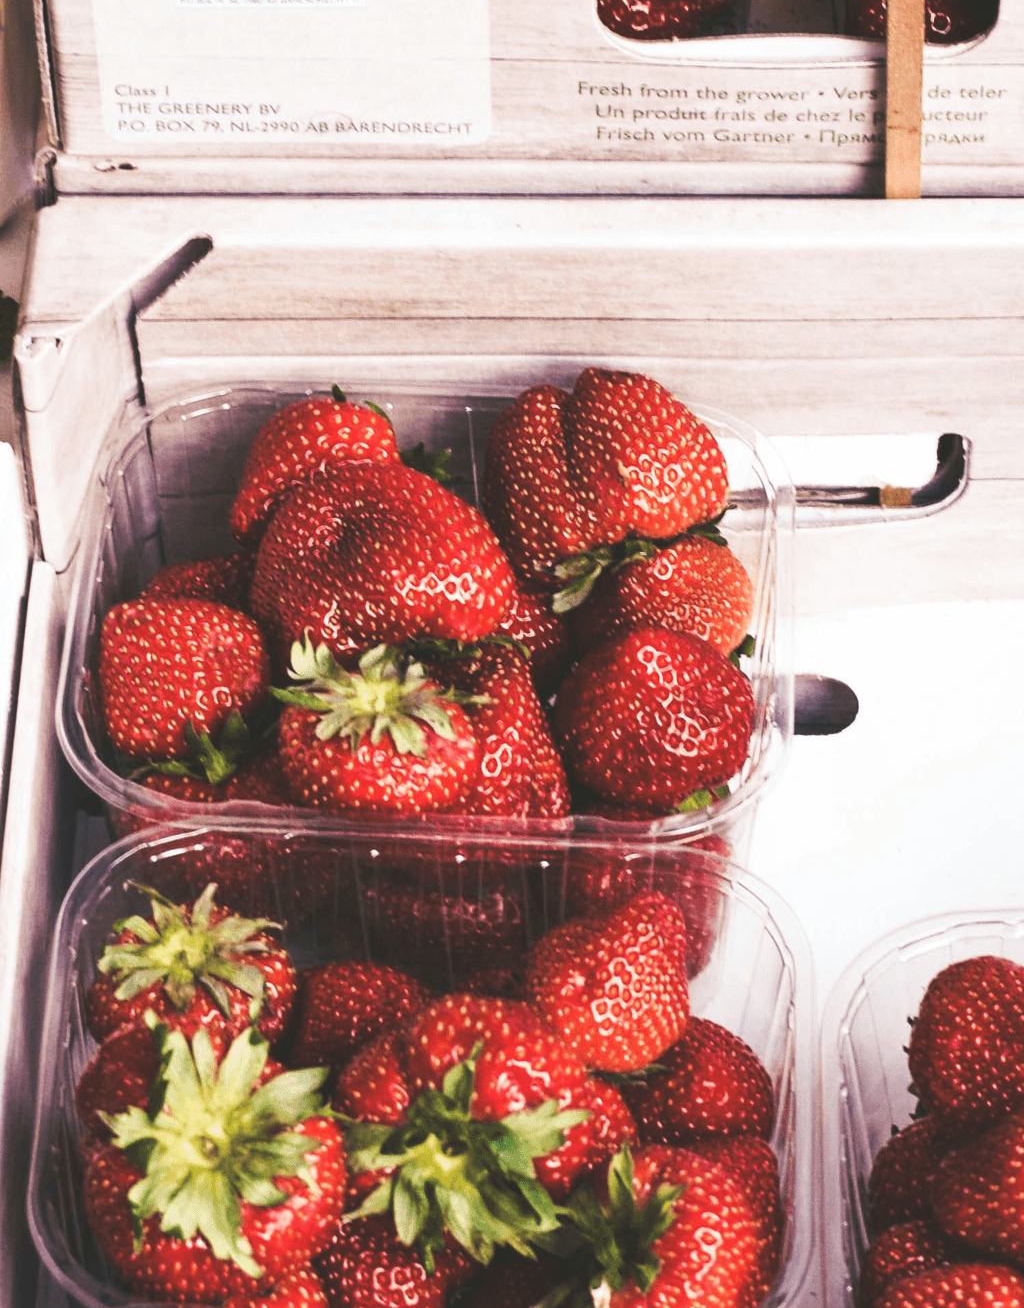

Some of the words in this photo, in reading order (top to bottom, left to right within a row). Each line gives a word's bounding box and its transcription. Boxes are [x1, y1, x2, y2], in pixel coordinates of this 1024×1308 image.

[114, 84, 157, 98] Class
[578, 81, 632, 97] Fresh
[640, 83, 688, 98] from
[697, 86, 728, 100] the
[736, 90, 809, 104] grower
[927, 85, 951, 99] de
[960, 85, 1007, 99] teler
[116, 102, 152, 116] THE
[159, 103, 253, 116] GREENERY
[258, 103, 282, 116] BV
[595, 104, 625, 119] Un
[632, 107, 706, 122] produit
[714, 107, 756, 122] frais
[764, 109, 788, 122] de
[796, 109, 841, 122] chez
[849, 108, 866, 122] le
[155, 120, 197, 134] BOX
[305, 121, 330, 134] AB
[335, 121, 473, 135] BARENDRECHT
[596, 126, 655, 141] Frisch
[663, 130, 705, 141] vom
